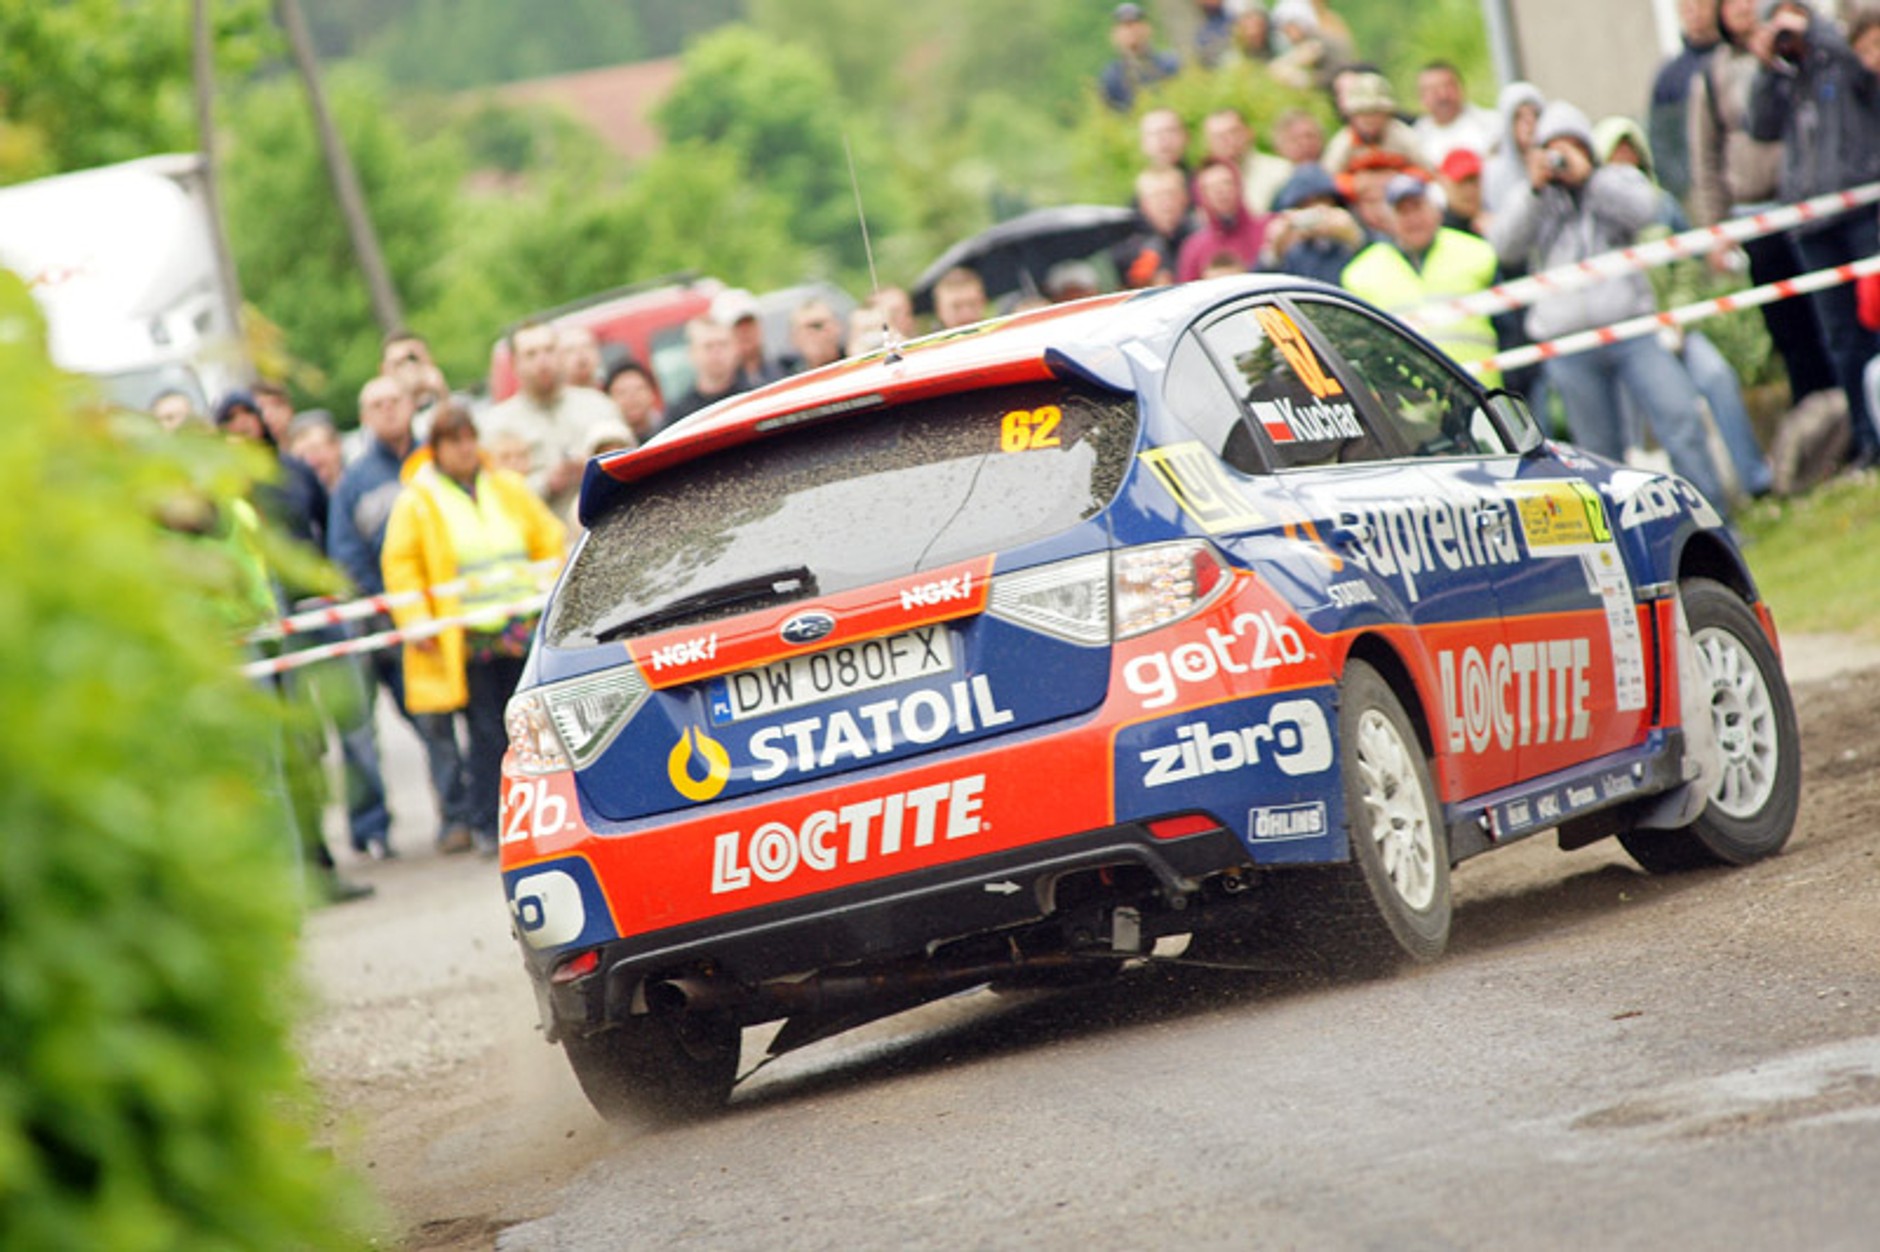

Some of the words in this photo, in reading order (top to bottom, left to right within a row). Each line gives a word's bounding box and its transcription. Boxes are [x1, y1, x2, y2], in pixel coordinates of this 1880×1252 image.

[1001, 405, 1063, 453] 62
[1274, 394, 1365, 442] Kuchar
[733, 661, 794, 713] DW
[809, 627, 943, 693] 080FX
[1123, 609, 1306, 709] got2b
[1438, 638, 1591, 754] LOCTITE
[749, 674, 1014, 782] STATOIL
[1140, 699, 1334, 788] zibro
[711, 773, 987, 894] LOCTITE
